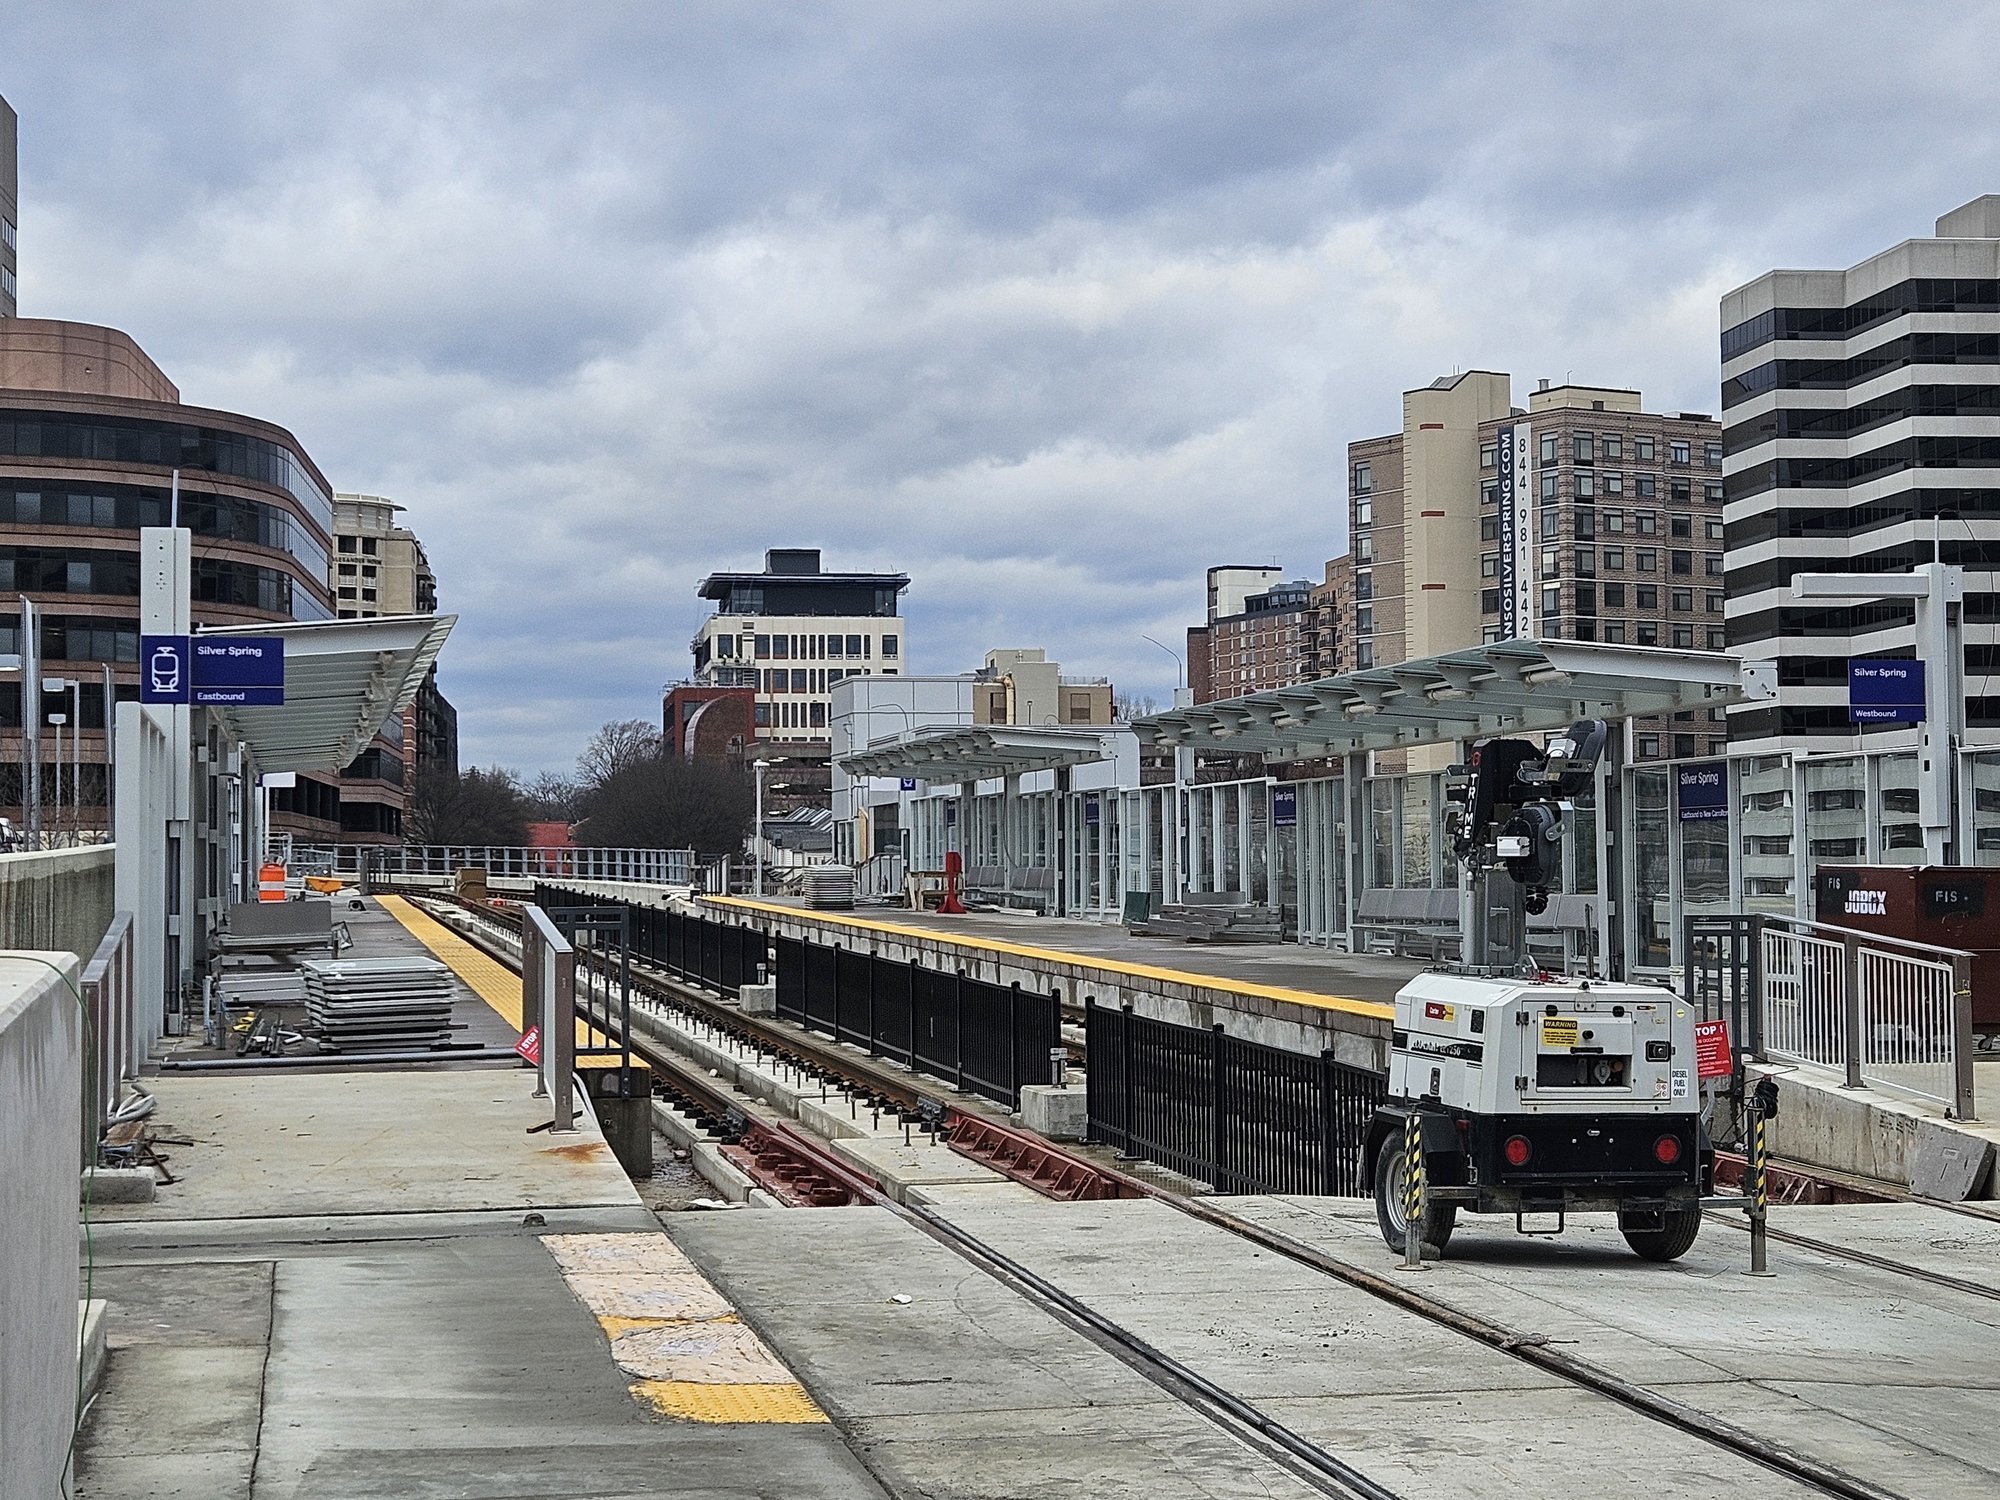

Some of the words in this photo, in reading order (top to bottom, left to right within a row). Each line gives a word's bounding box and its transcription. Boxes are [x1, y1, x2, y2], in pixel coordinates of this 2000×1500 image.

[197, 646, 226, 655] Silver
[228, 646, 262, 657] Spring
[1854, 668, 1877, 676] Silver
[1880, 668, 1907, 678] Spring
[197, 692, 245, 701] Eastbound
[1681, 772, 1697, 785] Silver
[1698, 770, 1719, 786] Spring
[1463, 773, 1479, 839] TRIME
[1828, 877, 1841, 889] FIS
[1935, 890, 1958, 902] FIS
[1695, 1025, 1717, 1037] TOP
[521, 1032, 537, 1049] STOP
[1672, 1070, 1688, 1078] DIESEL
[1674, 1079, 1685, 1087] FUEL
[1673, 1089, 1686, 1097] ONLY
